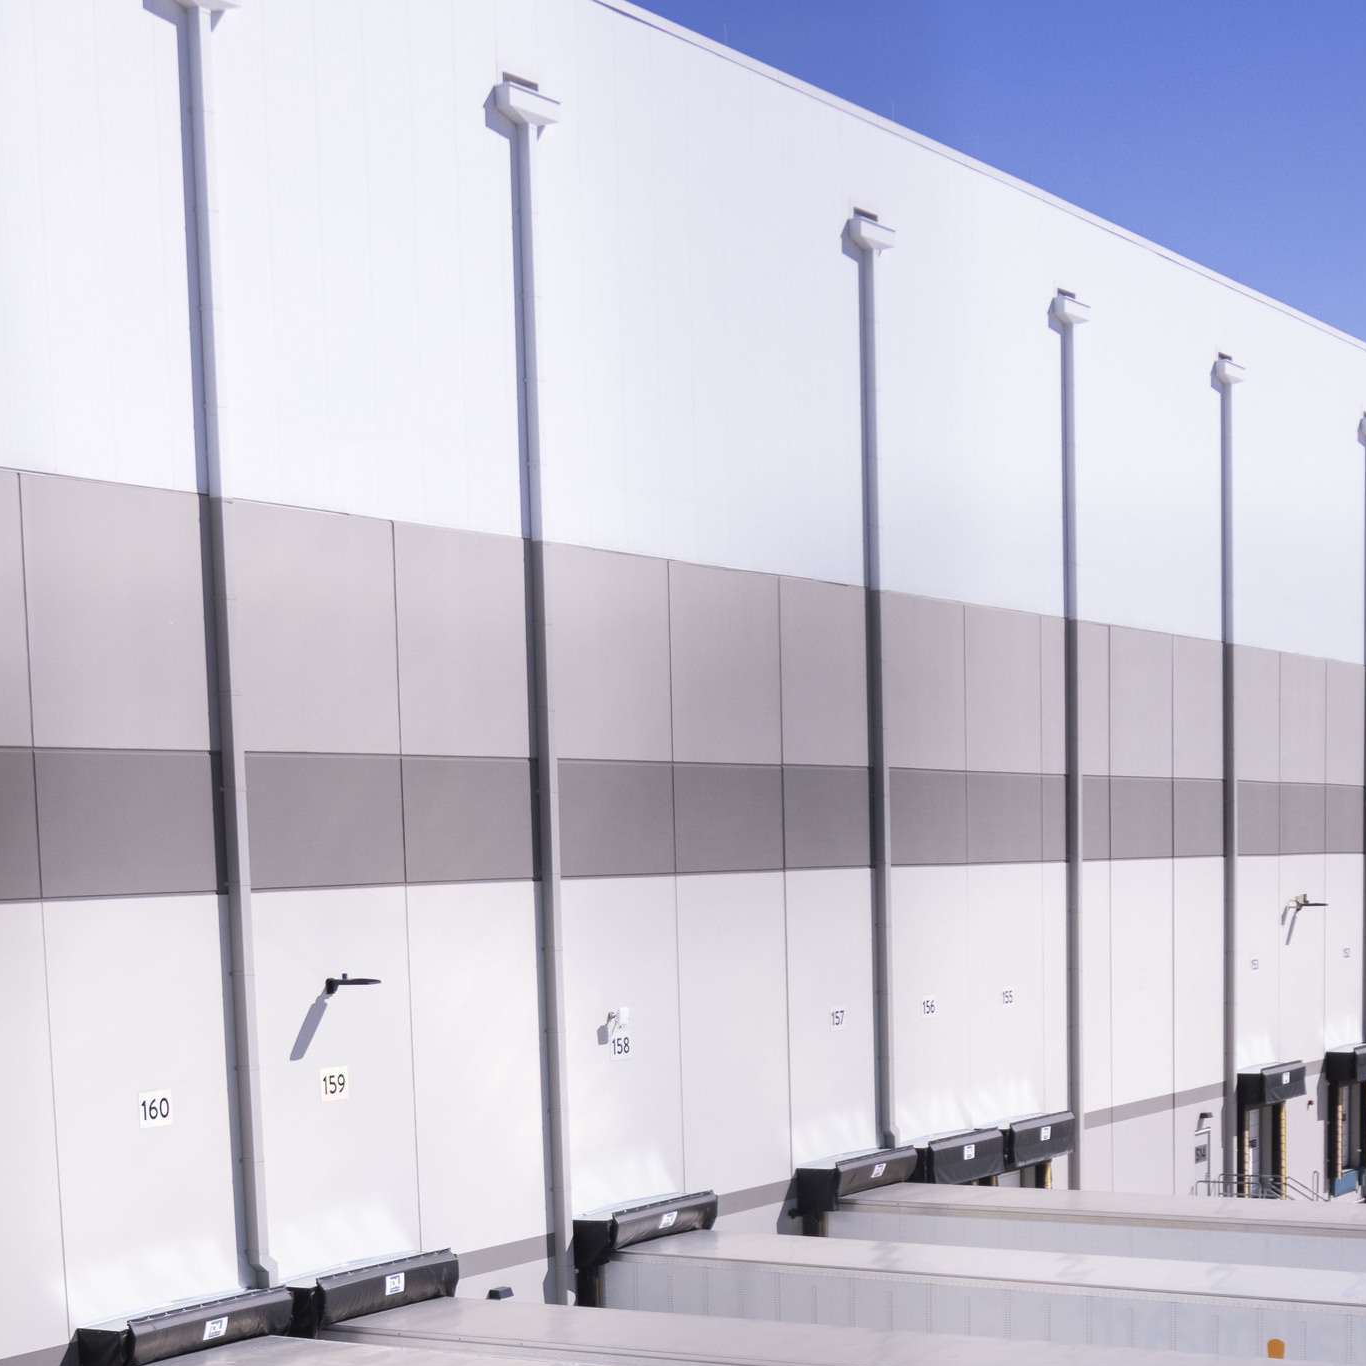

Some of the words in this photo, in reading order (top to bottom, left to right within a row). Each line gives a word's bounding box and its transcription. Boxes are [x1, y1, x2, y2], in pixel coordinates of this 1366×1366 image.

[1002, 990, 1013, 1004] 155
[923, 1000, 935, 1014] 156
[831, 1010, 844, 1026] 157
[611, 1036, 629, 1055] 158
[322, 1073, 346, 1095] 159
[140, 1097, 170, 1121] 160
